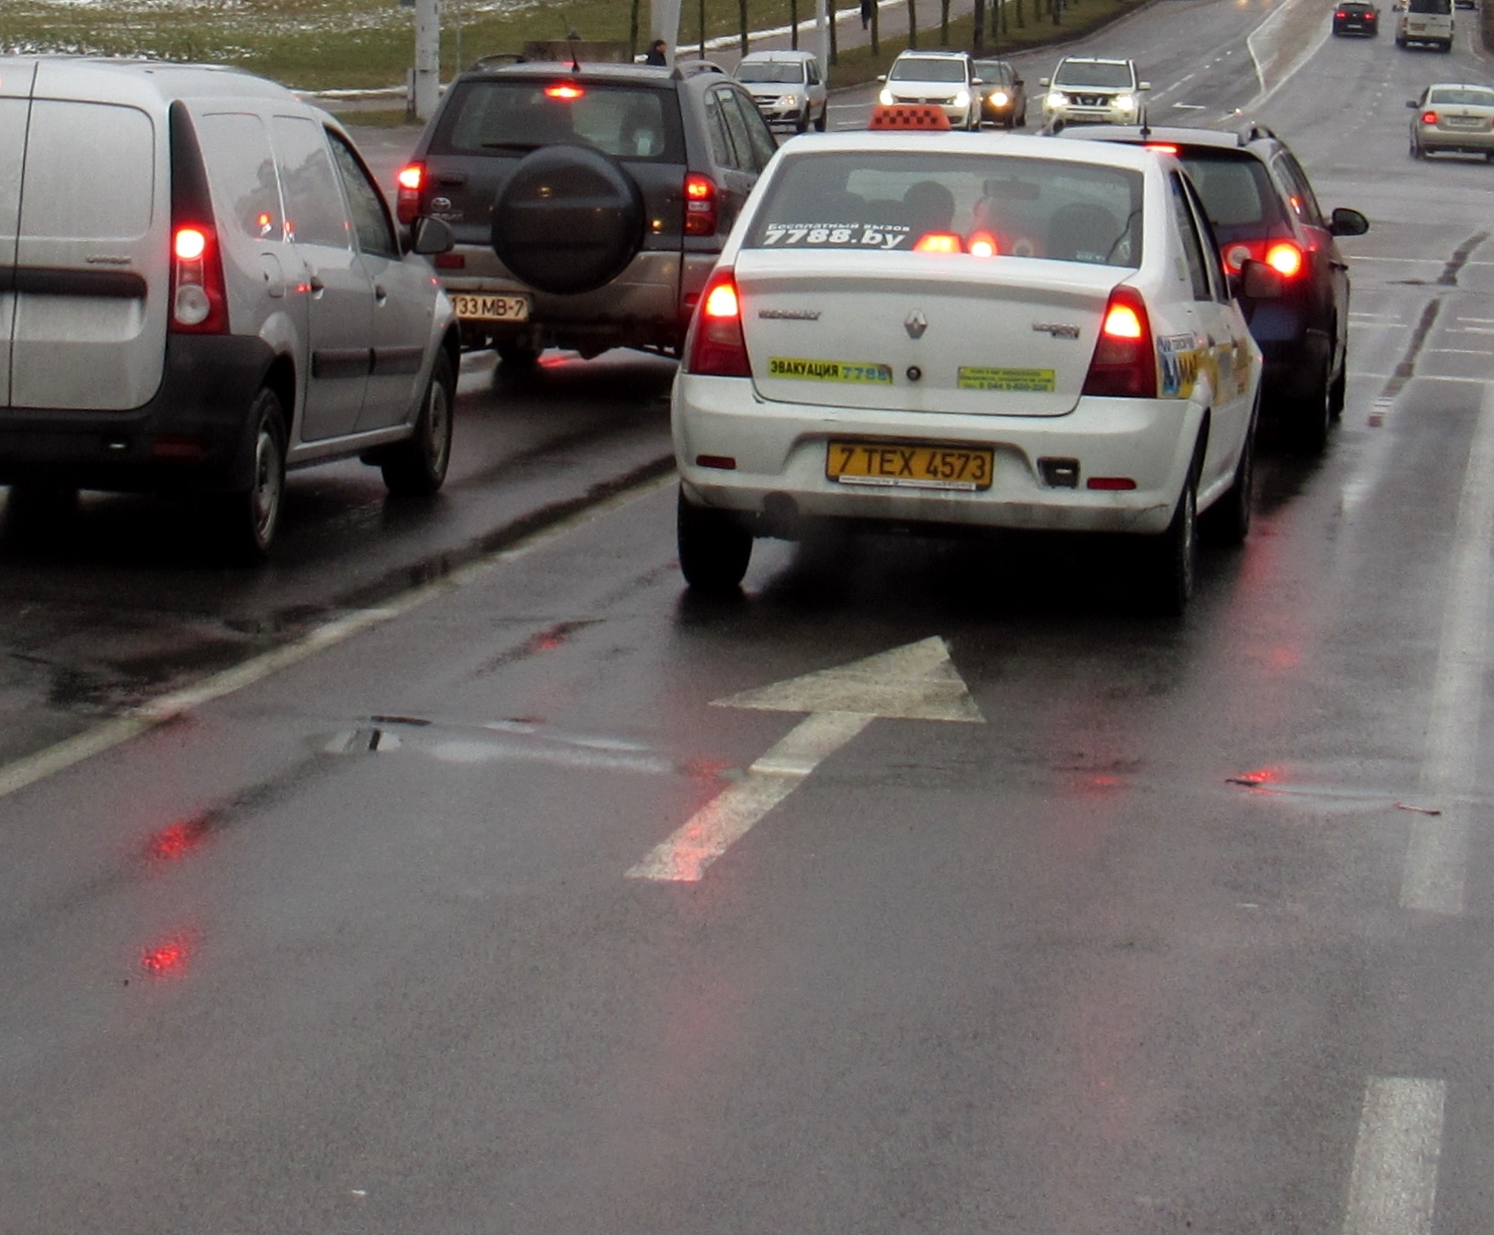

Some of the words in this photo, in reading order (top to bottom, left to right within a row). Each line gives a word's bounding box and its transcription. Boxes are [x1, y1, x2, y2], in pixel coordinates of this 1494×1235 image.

[768, 222, 860, 231] Бесплатный
[863, 224, 911, 232] вызов
[763, 228, 907, 249] 7788.by
[482, 299, 524, 317] MB-7
[771, 360, 840, 379] ЭВАКУАЦИЯ
[839, 447, 855, 473] 7
[862, 448, 916, 476] TEX
[925, 451, 986, 480] 4573
